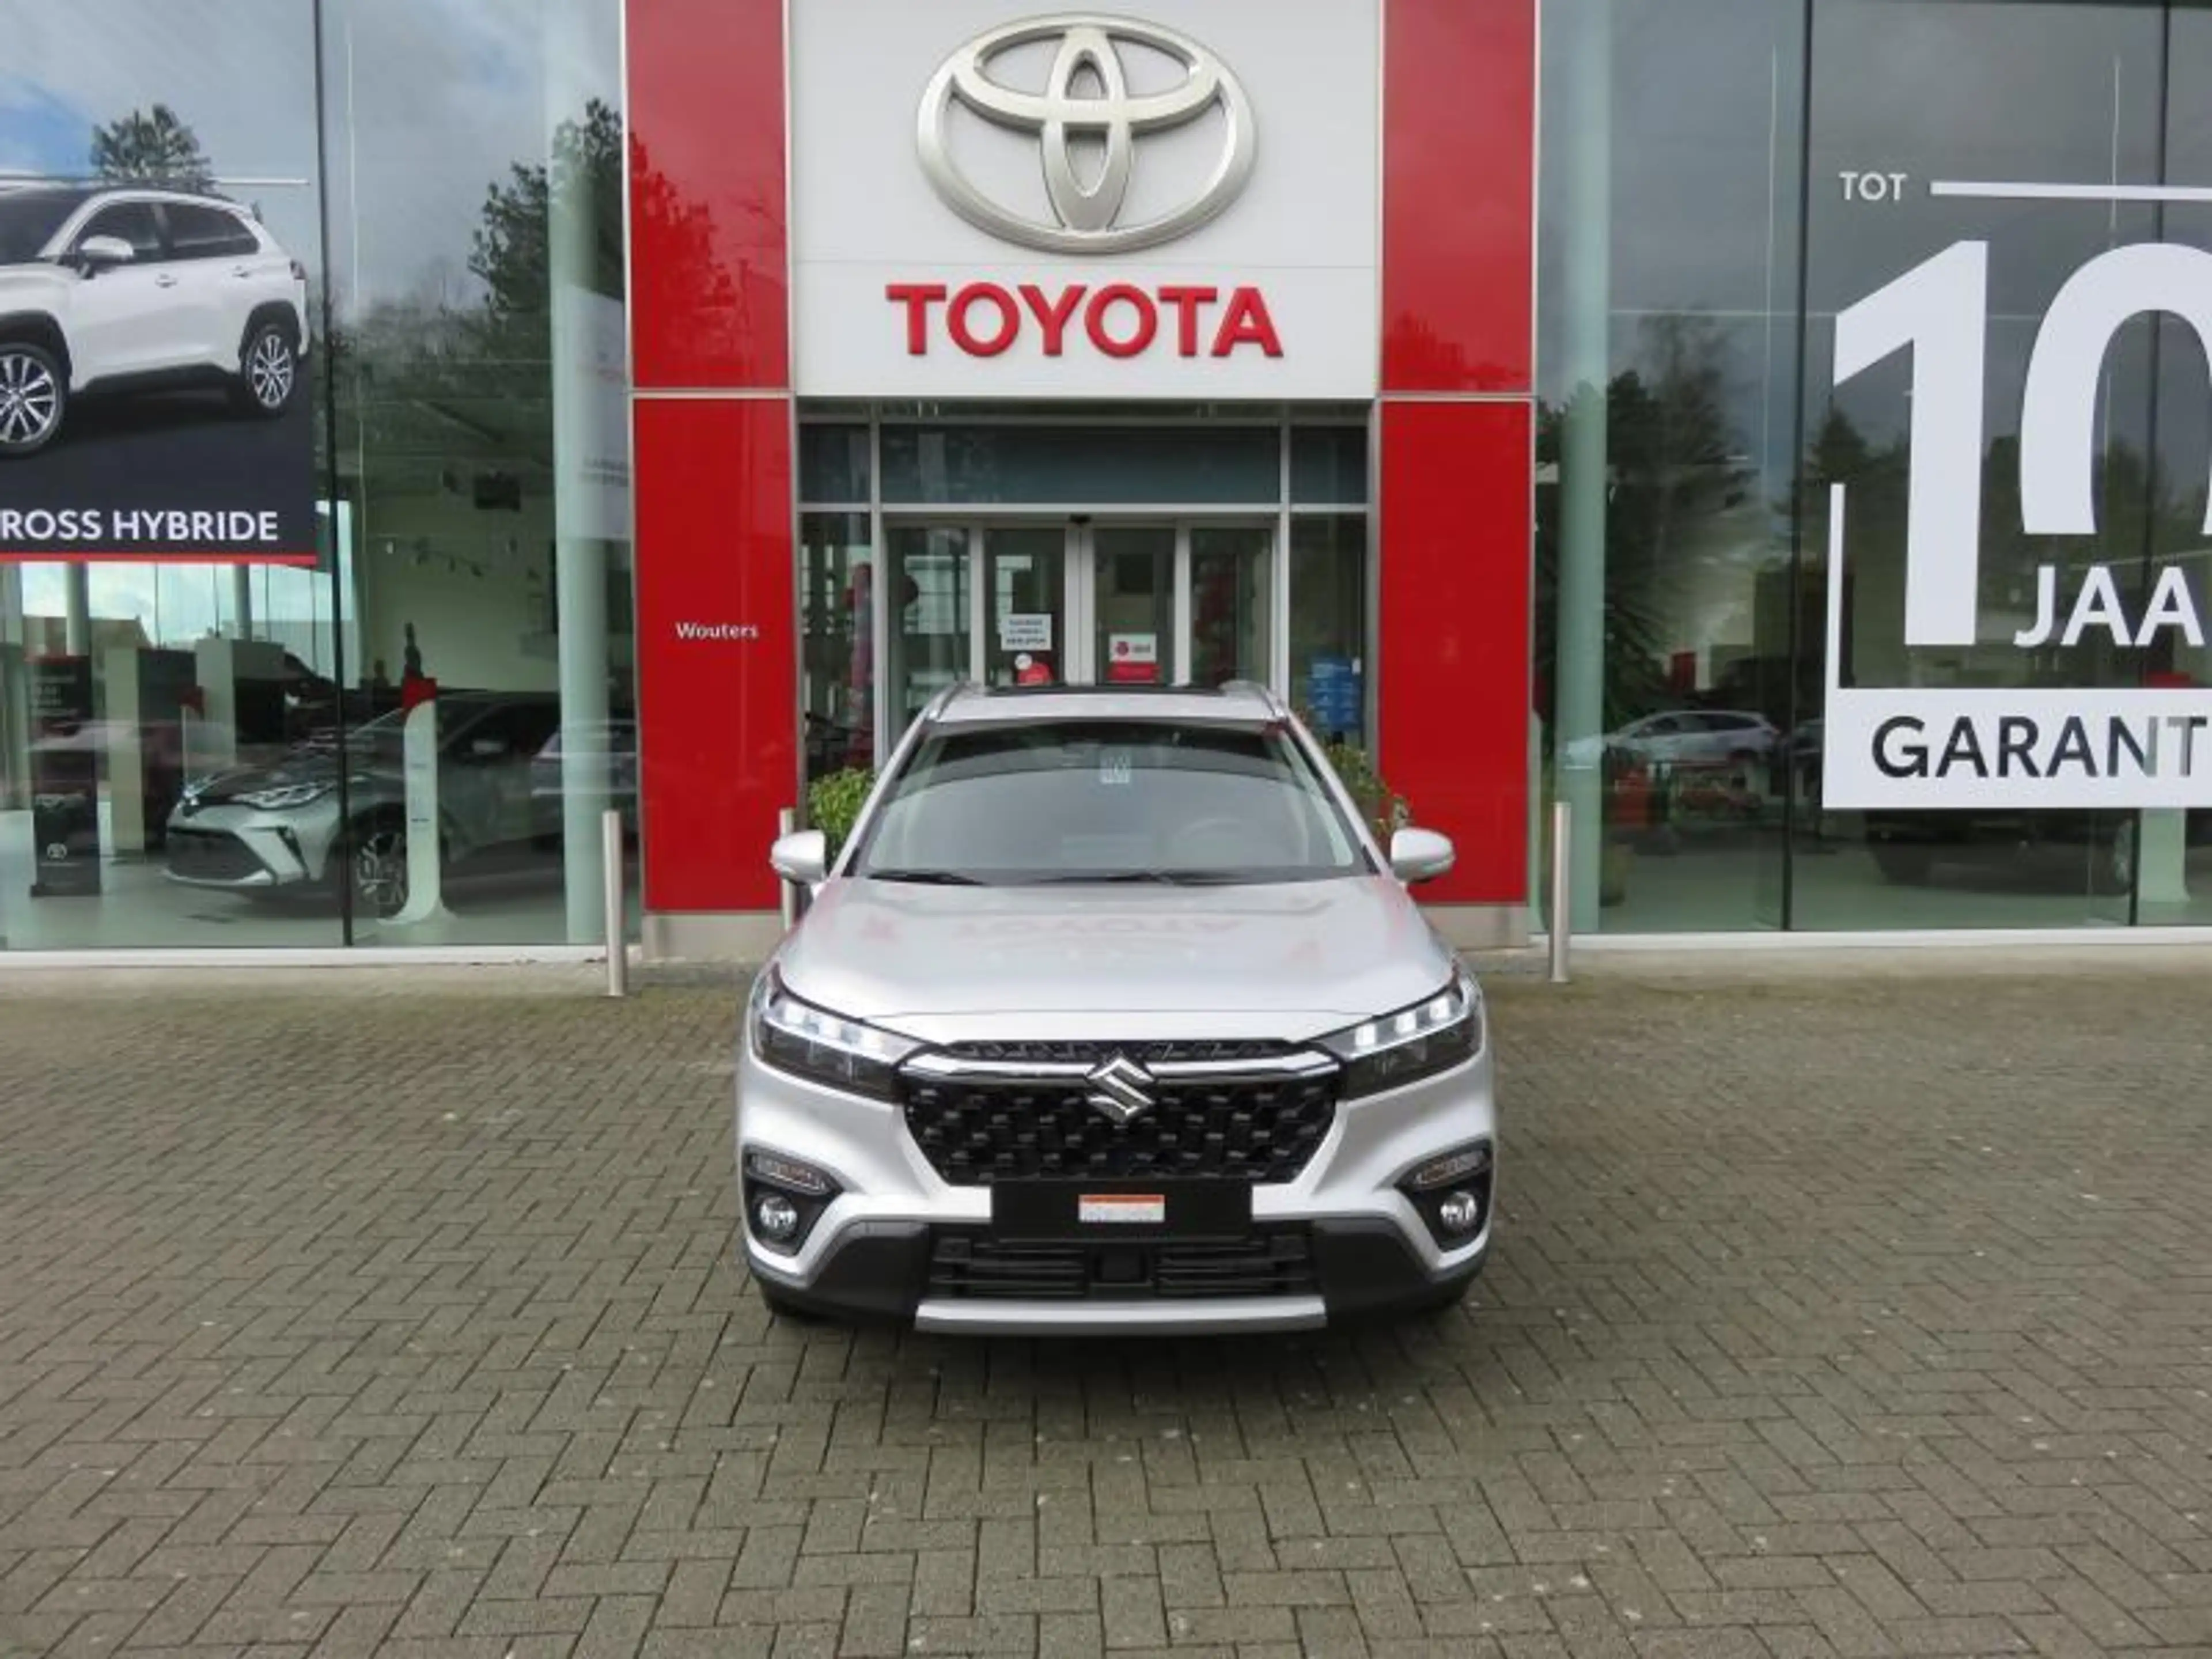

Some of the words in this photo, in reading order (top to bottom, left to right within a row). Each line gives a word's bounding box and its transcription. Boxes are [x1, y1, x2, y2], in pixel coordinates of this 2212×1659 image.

[1839, 171, 1908, 201] TOT
[886, 282, 1283, 358] TOYOTA
[113, 510, 278, 540] HYBRIDE
[2014, 566, 2206, 647] JAA
[675, 622, 759, 640] Wouters
[1872, 715, 2207, 778] GARANT
